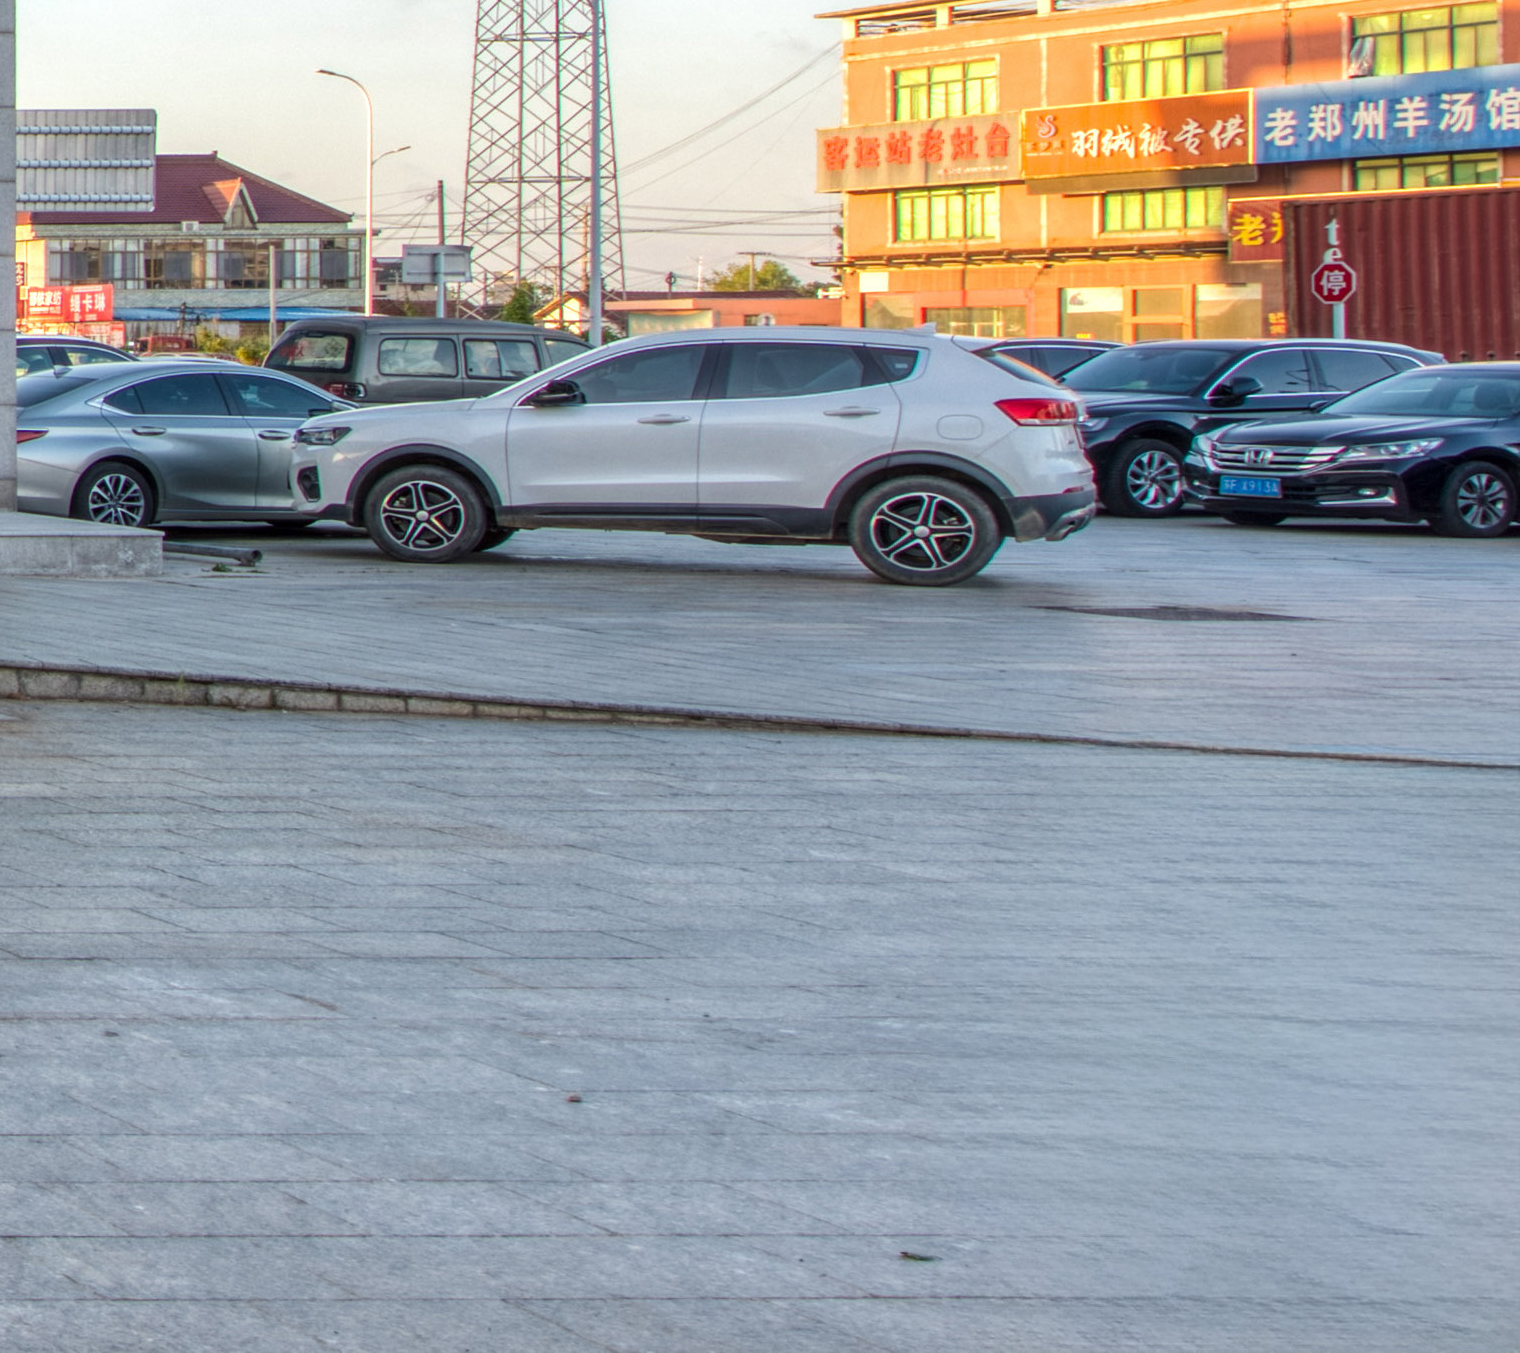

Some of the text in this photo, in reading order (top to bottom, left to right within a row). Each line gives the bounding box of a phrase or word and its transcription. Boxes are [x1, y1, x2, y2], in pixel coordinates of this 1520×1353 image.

[1264, 87, 1520, 147] 老郑州羊汤馆
[823, 122, 1011, 171] 客运站老灶台
[1319, 269, 1347, 296] 停
